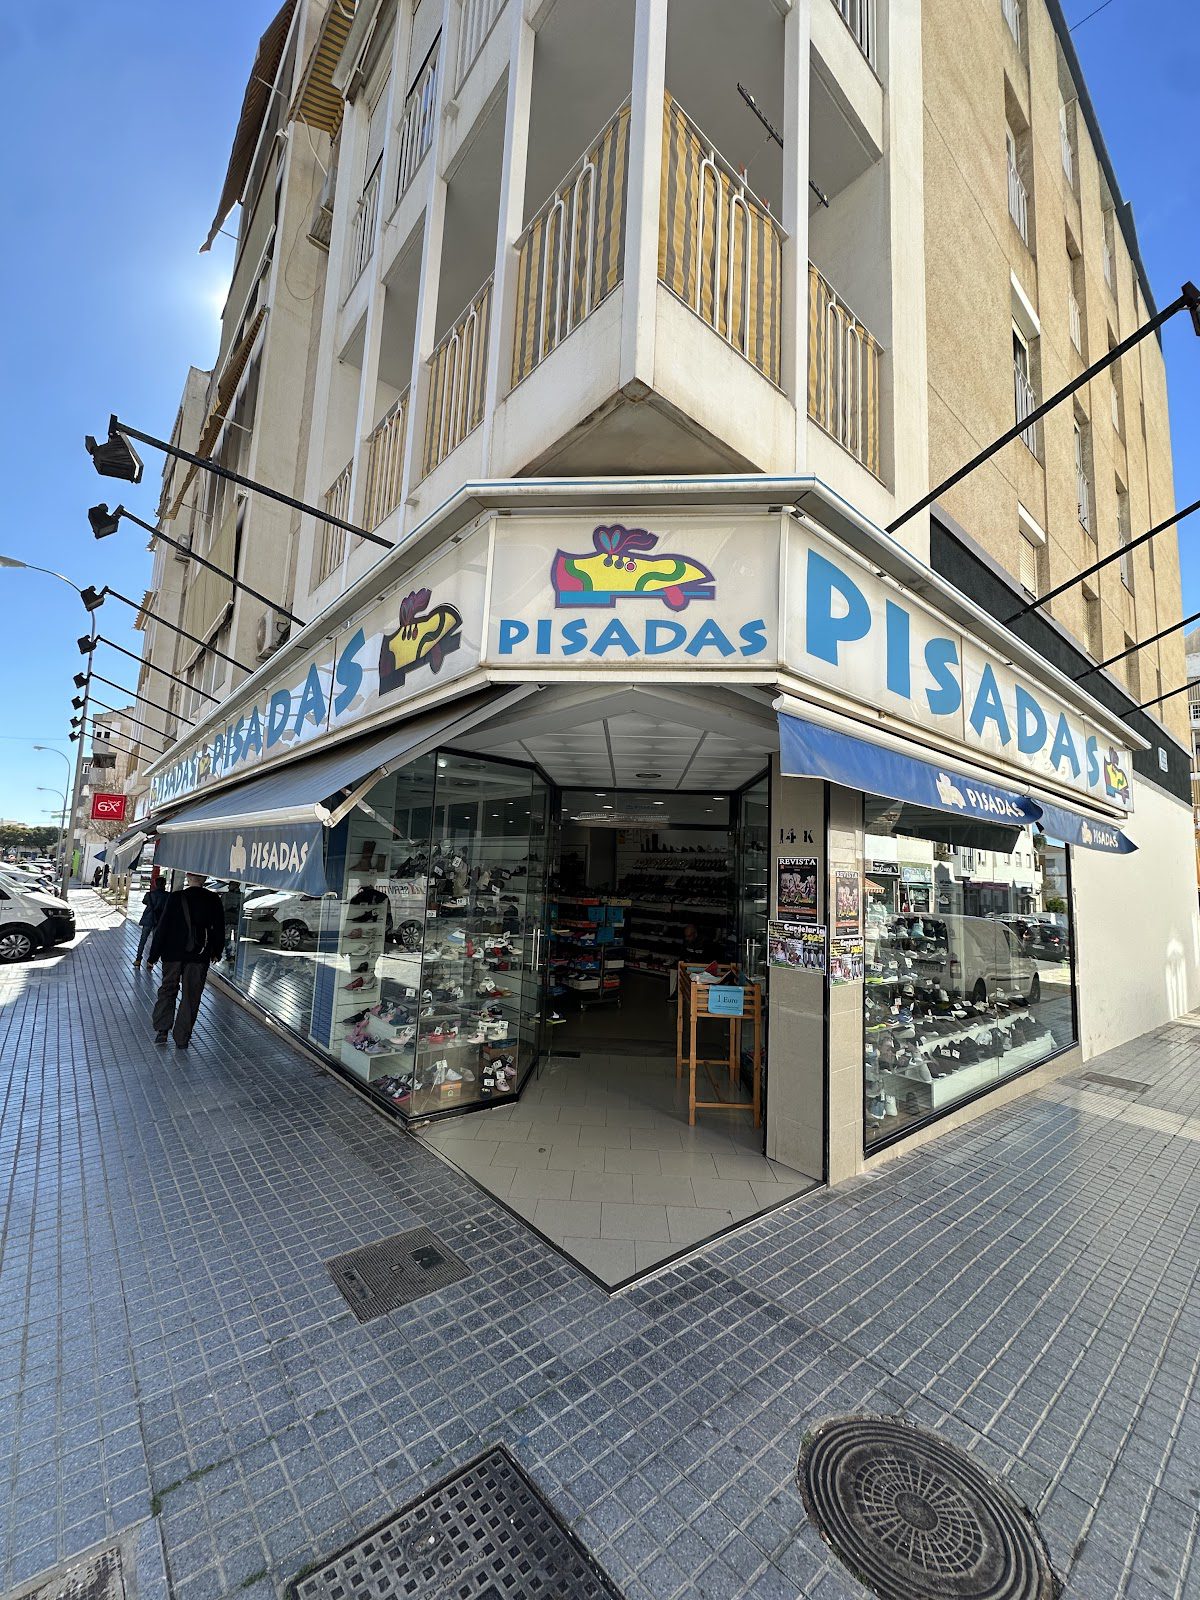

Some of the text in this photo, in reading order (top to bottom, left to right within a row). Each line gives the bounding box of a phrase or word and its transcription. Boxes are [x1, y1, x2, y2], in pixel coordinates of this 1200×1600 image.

[498, 618, 768, 657] PISADAS
[806, 548, 1100, 788] PISADAS
[212, 627, 366, 775] PISADAS
[966, 788, 1025, 818] PISADAS
[779, 828, 814, 844] 14 K
[1092, 828, 1119, 848] PISADAS
[250, 841, 309, 874] PISADAS
[779, 858, 816, 866] REVISTA
[836, 871, 859, 879] REVISTA
[802, 932, 825, 943] 2025
